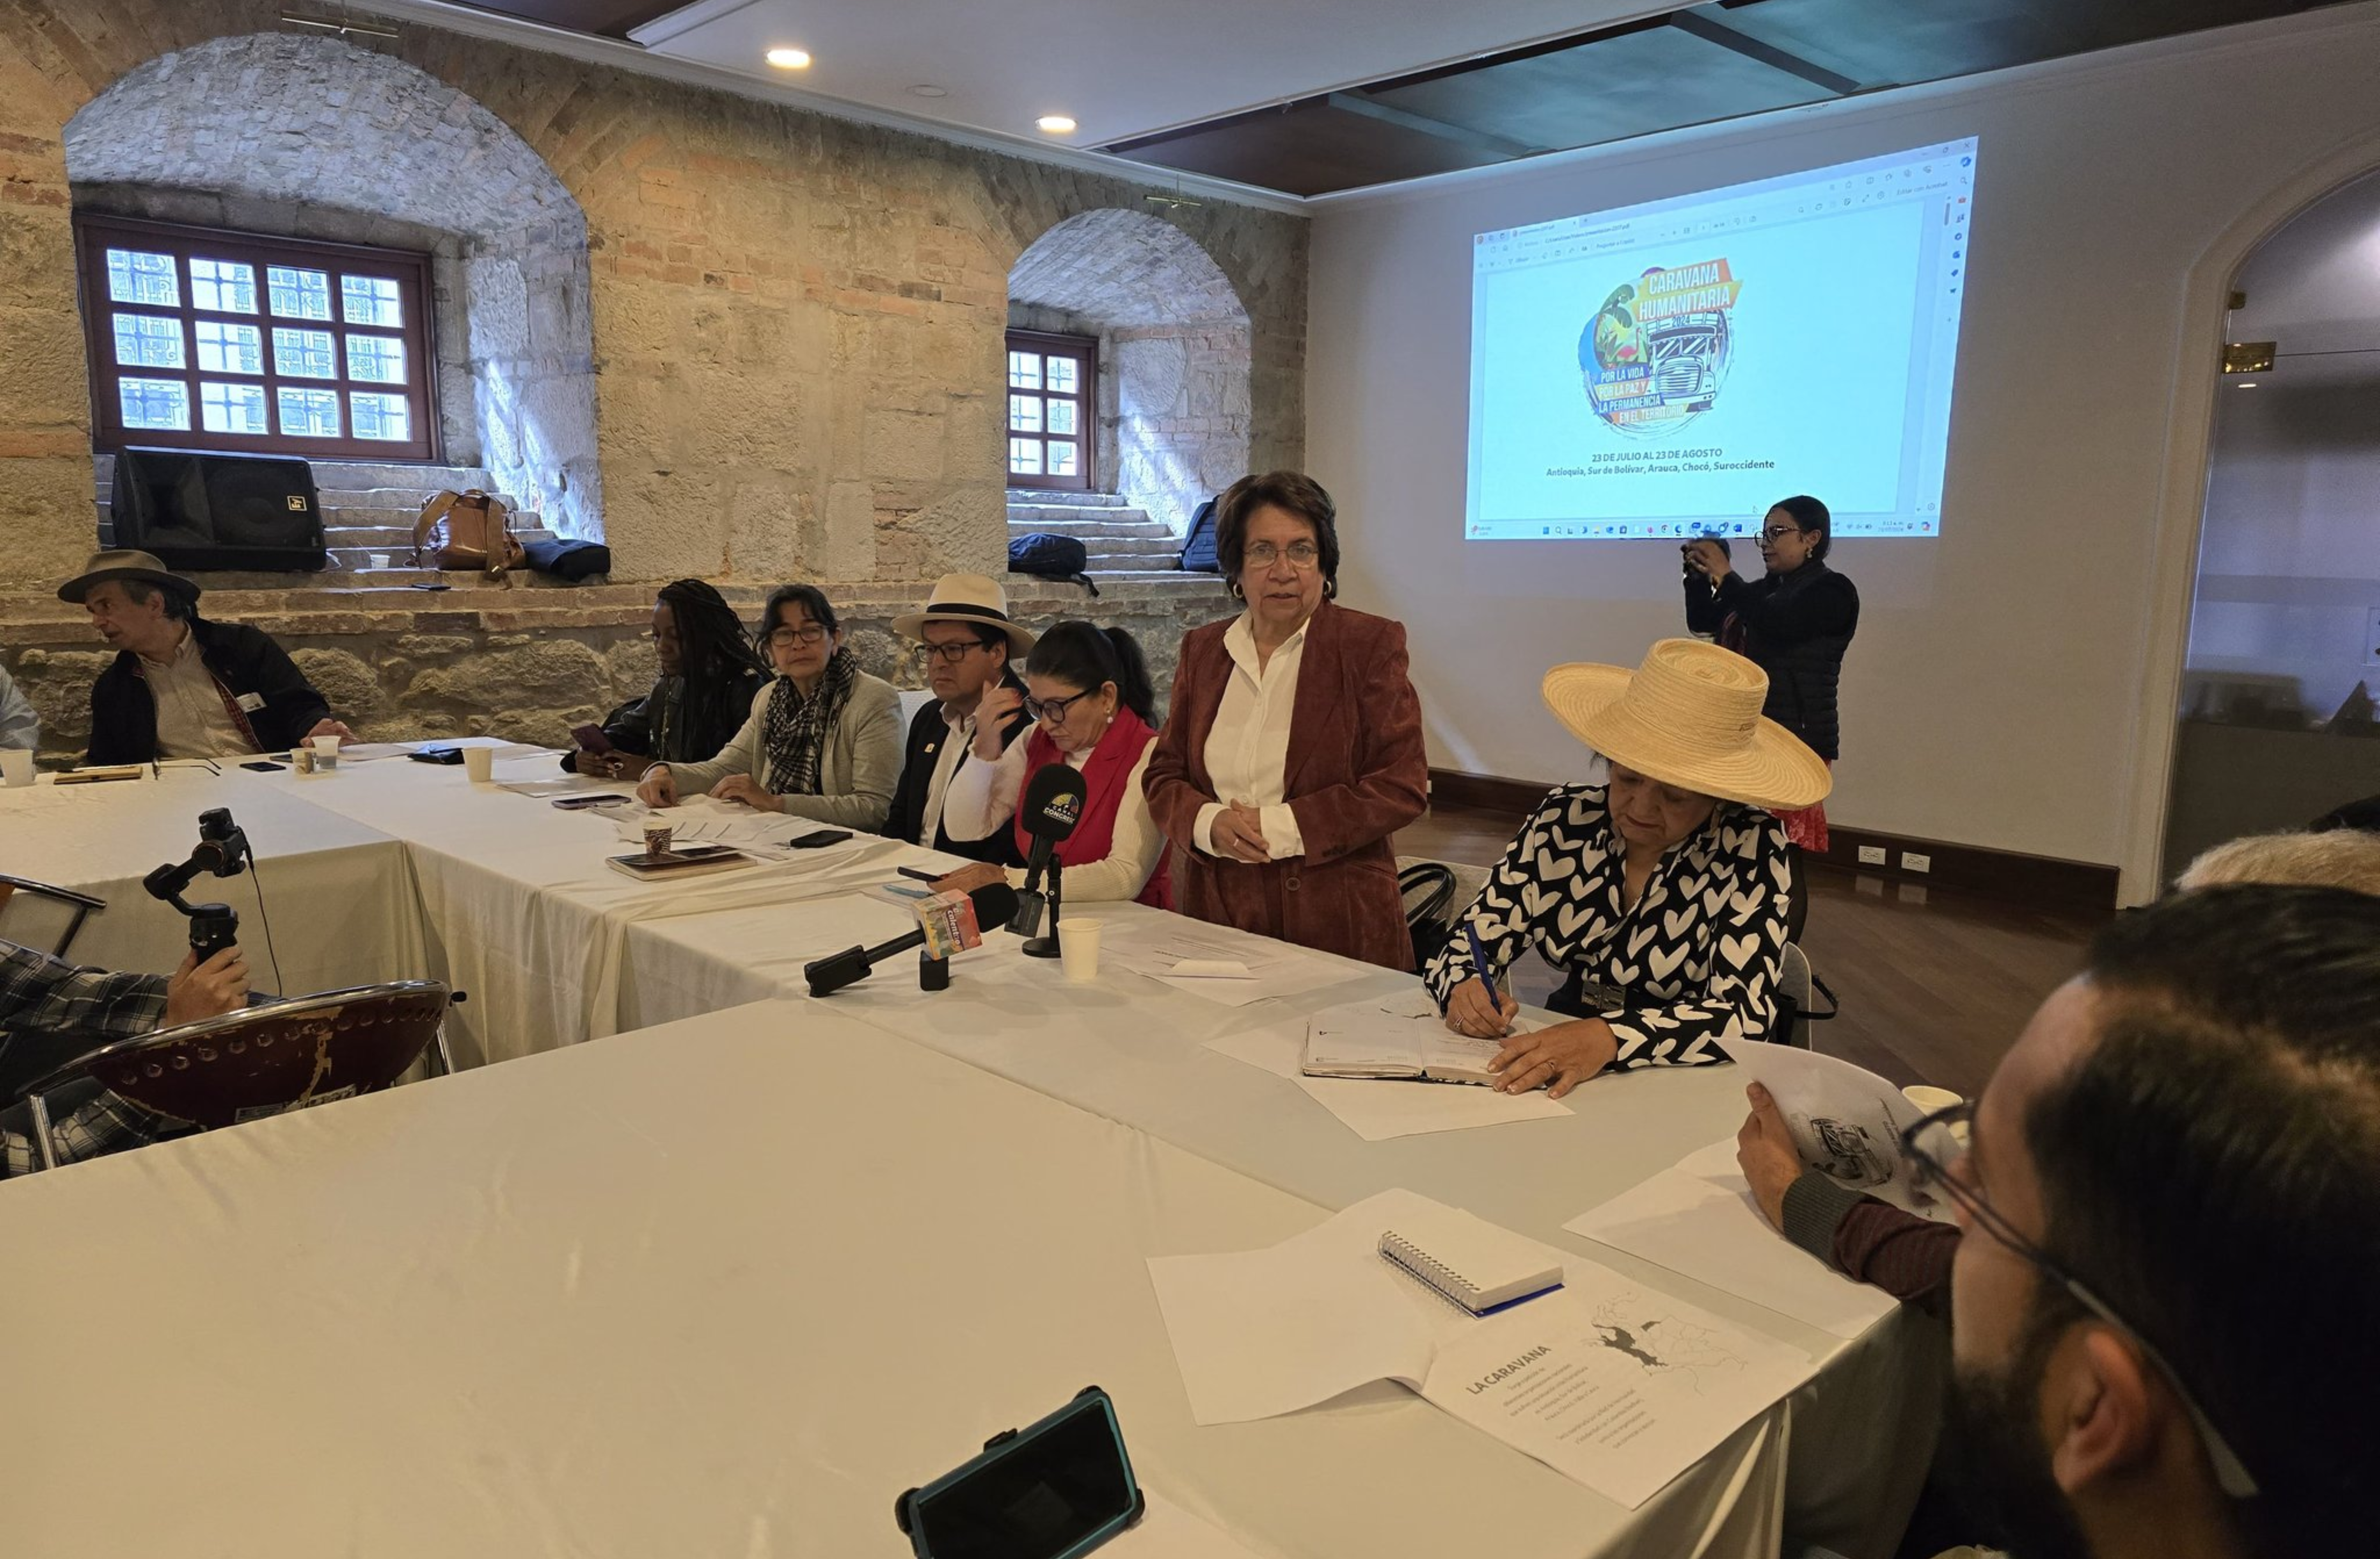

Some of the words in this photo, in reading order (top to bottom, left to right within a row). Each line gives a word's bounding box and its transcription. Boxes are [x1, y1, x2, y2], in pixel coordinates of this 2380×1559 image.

[1649, 263, 1719, 295] CARAVANA
[1639, 286, 1730, 320] HUMANITARIA
[1672, 315, 1690, 327] 2024
[1601, 370, 1615, 383] POR
[1617, 369, 1626, 380] LA
[1628, 367, 1644, 379] VIDA
[1600, 386, 1614, 398] POR
[1615, 385, 1624, 396] LA
[1625, 382, 1639, 395] PAZ
[1641, 381, 1646, 392] Y
[1599, 402, 1608, 412] LA
[1609, 395, 1661, 411] PERMANENCIA
[1620, 411, 1629, 423] EN
[1631, 410, 1638, 421] EL
[1641, 405, 1684, 420] TERRITORIO
[1592, 454, 1601, 462] 23
[1603, 453, 1615, 462] DE
[1616, 452, 1641, 461] JULIO
[1643, 452, 1654, 460] AL
[1668, 450, 1680, 459] DE
[1682, 448, 1723, 458] AGOSTO
[1546, 467, 1586, 478] Antioquia,
[1588, 466, 1601, 475] Sur
[1603, 466, 1613, 474] de
[1614, 465, 1646, 474] Bolívar,
[1648, 464, 1681, 473] Arauca,
[1682, 462, 1712, 472] Chocó,
[1714, 460, 1775, 470] Suroccidente
[1044, 807, 1075, 824] CONGRE
[1465, 1382, 1490, 1395] LA
[1484, 1346, 1552, 1384] CARAVANA
